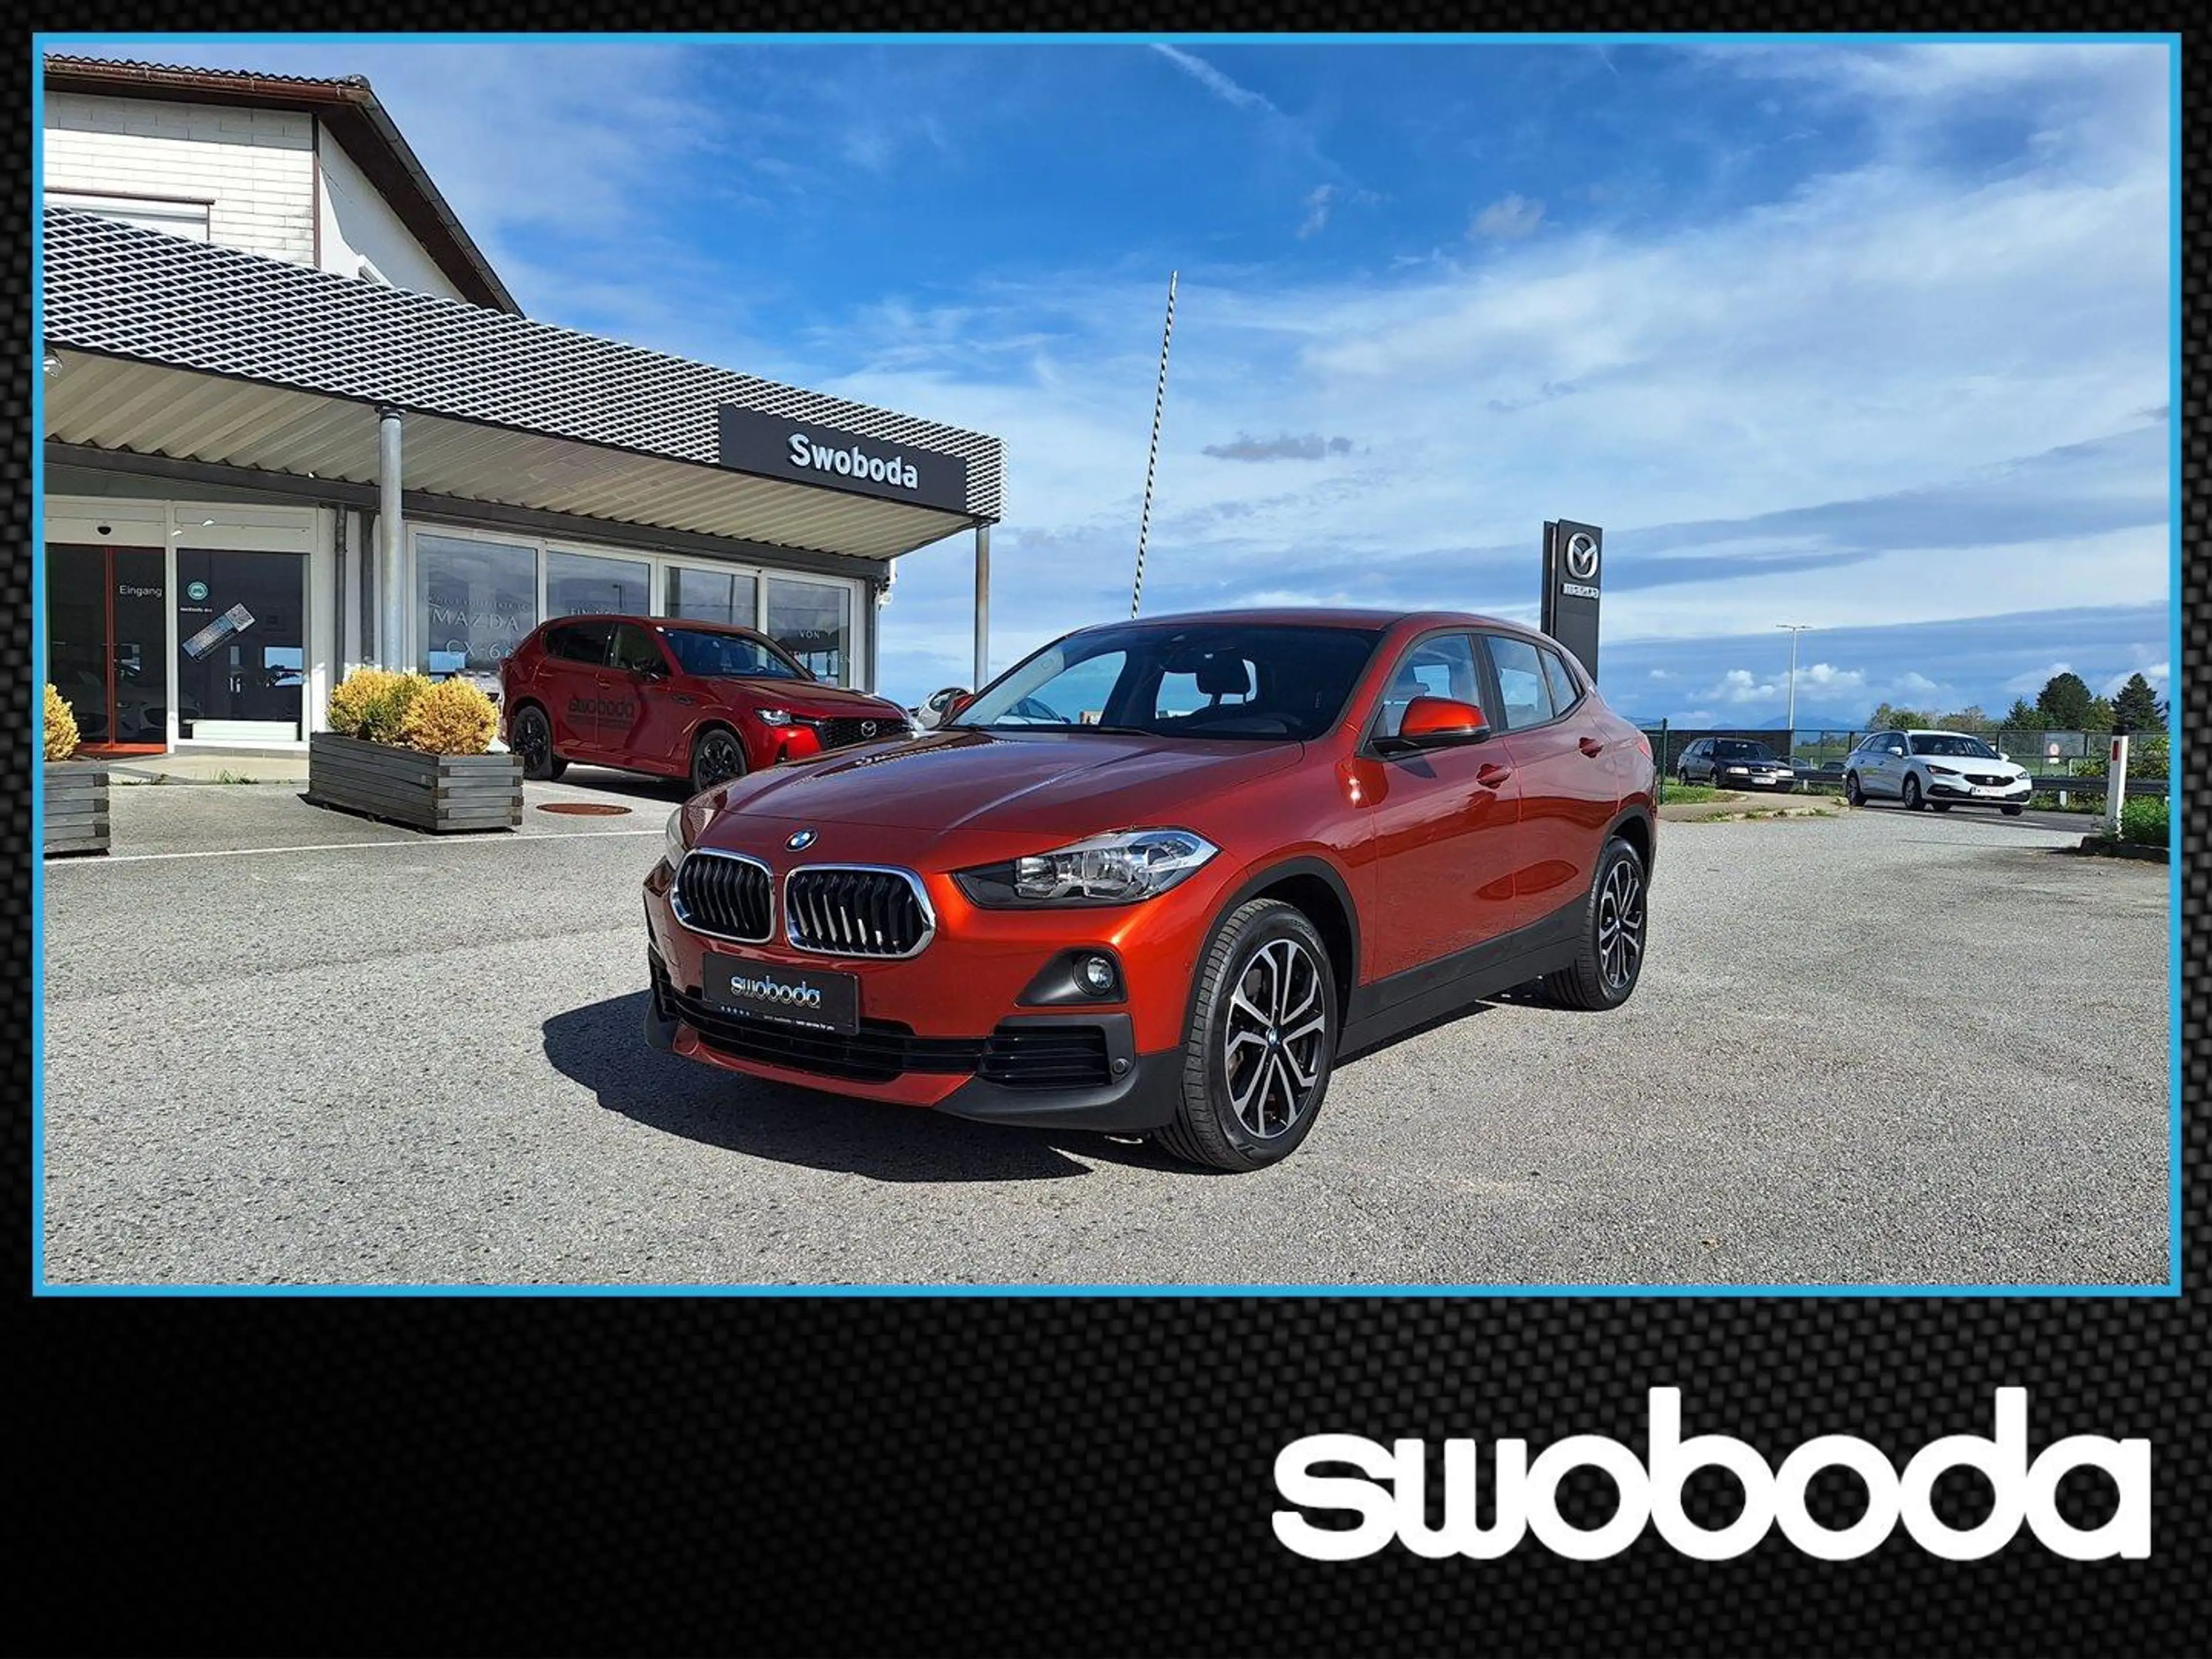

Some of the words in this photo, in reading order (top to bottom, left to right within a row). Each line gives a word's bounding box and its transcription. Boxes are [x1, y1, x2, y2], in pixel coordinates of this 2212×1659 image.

[788, 433, 919, 489] Swoboda
[119, 585, 162, 598] Eingang
[433, 608, 519, 631] MAZDA
[730, 975, 820, 1009] swoboda
